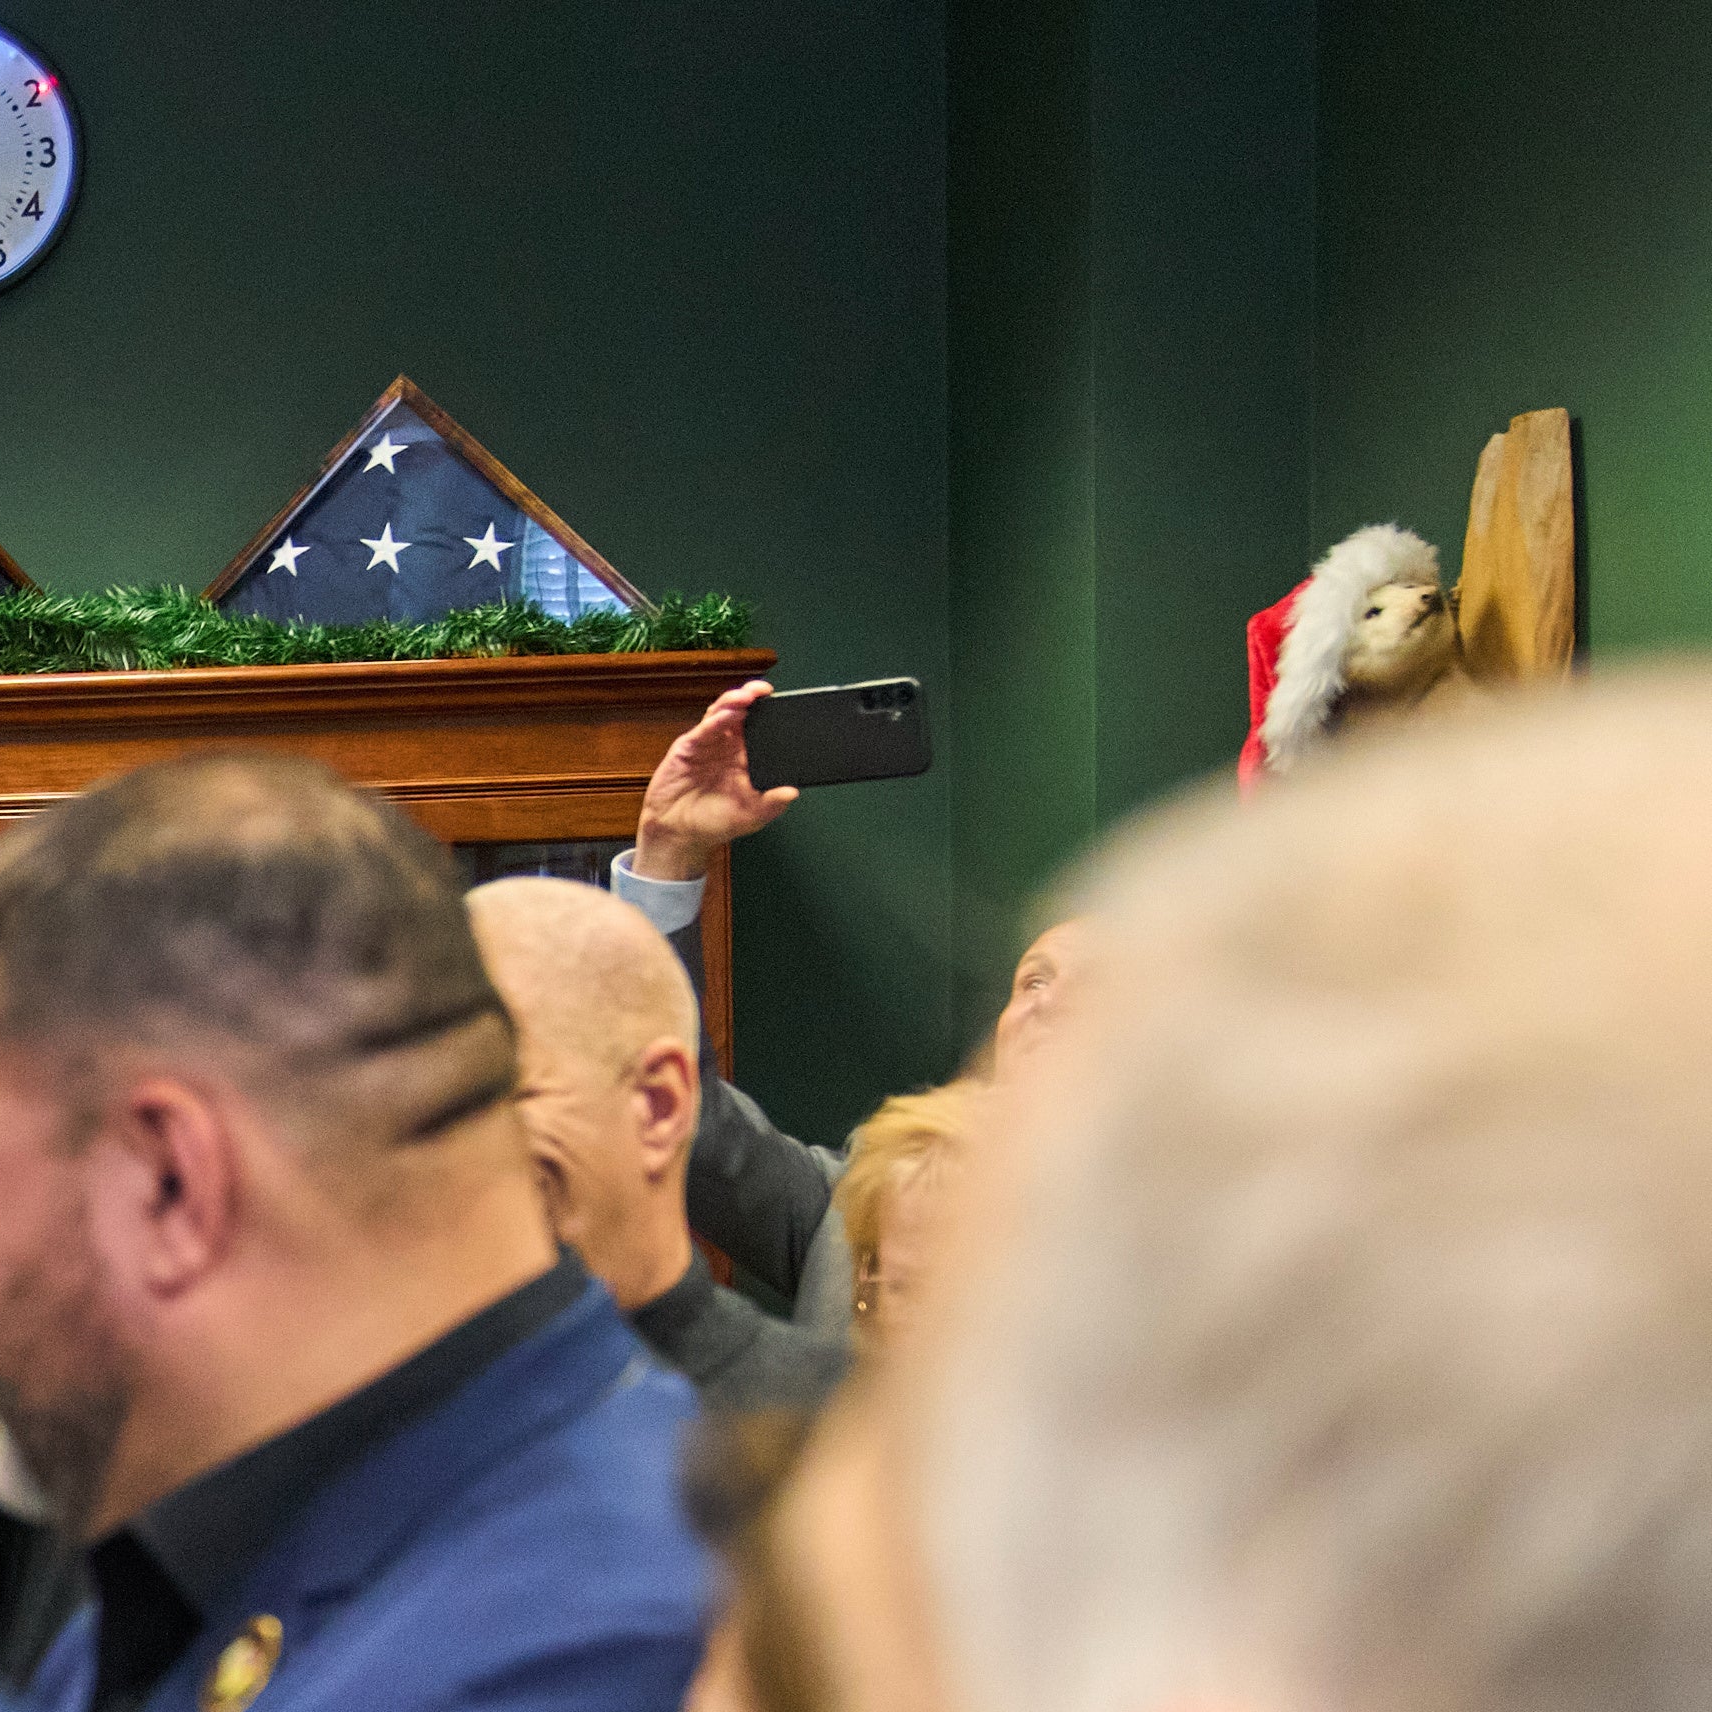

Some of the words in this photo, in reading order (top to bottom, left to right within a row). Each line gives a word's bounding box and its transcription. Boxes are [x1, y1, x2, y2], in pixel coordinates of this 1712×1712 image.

[24, 79, 42, 108] 2
[39, 137, 57, 168] 3
[21, 190, 44, 222] 4
